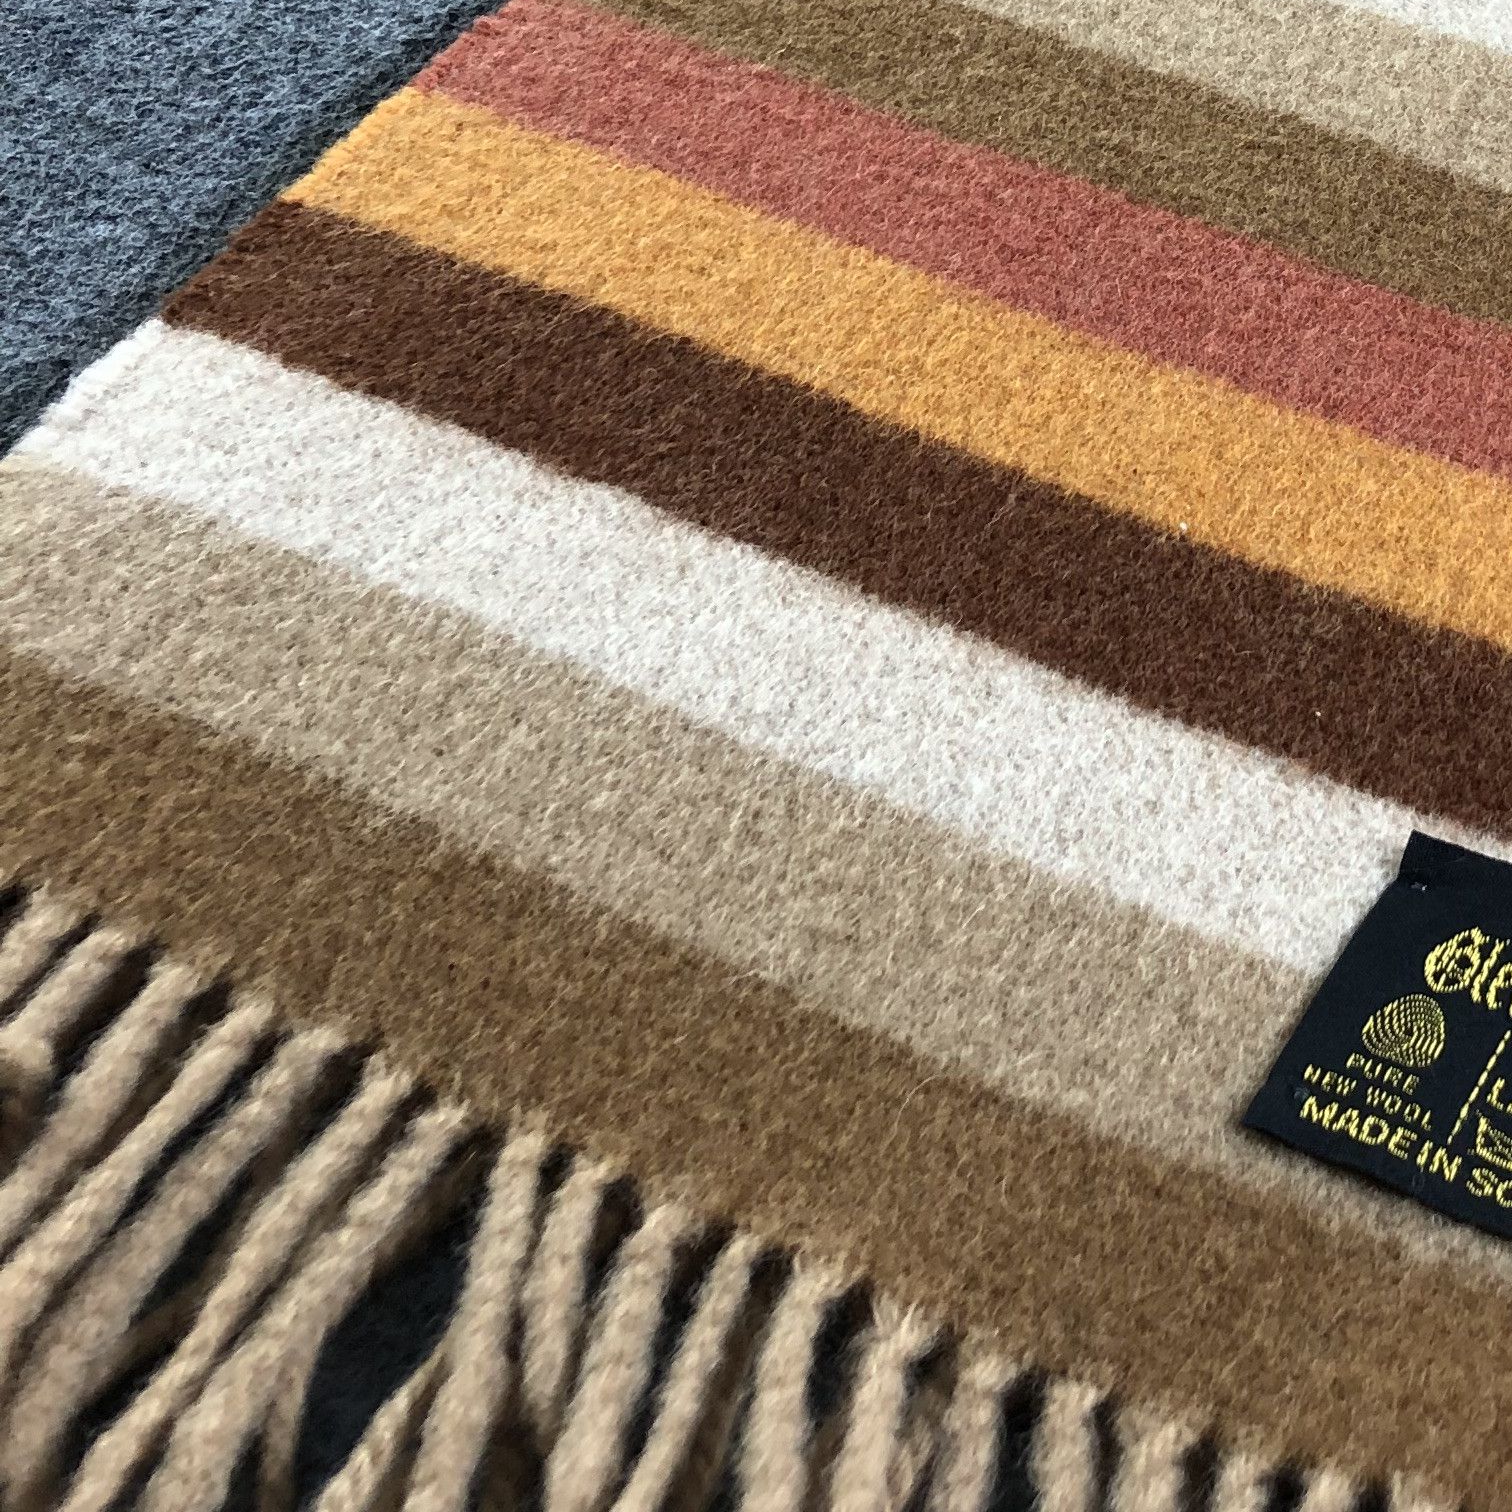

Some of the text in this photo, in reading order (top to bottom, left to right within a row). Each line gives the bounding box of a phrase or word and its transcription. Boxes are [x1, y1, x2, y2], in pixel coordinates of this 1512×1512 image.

[1303, 1063, 1433, 1131] NEW WOOL
[1345, 1052, 1420, 1096] PURE
[1299, 1095, 1418, 1160] MADE
[1416, 1139, 1463, 1182] IN
